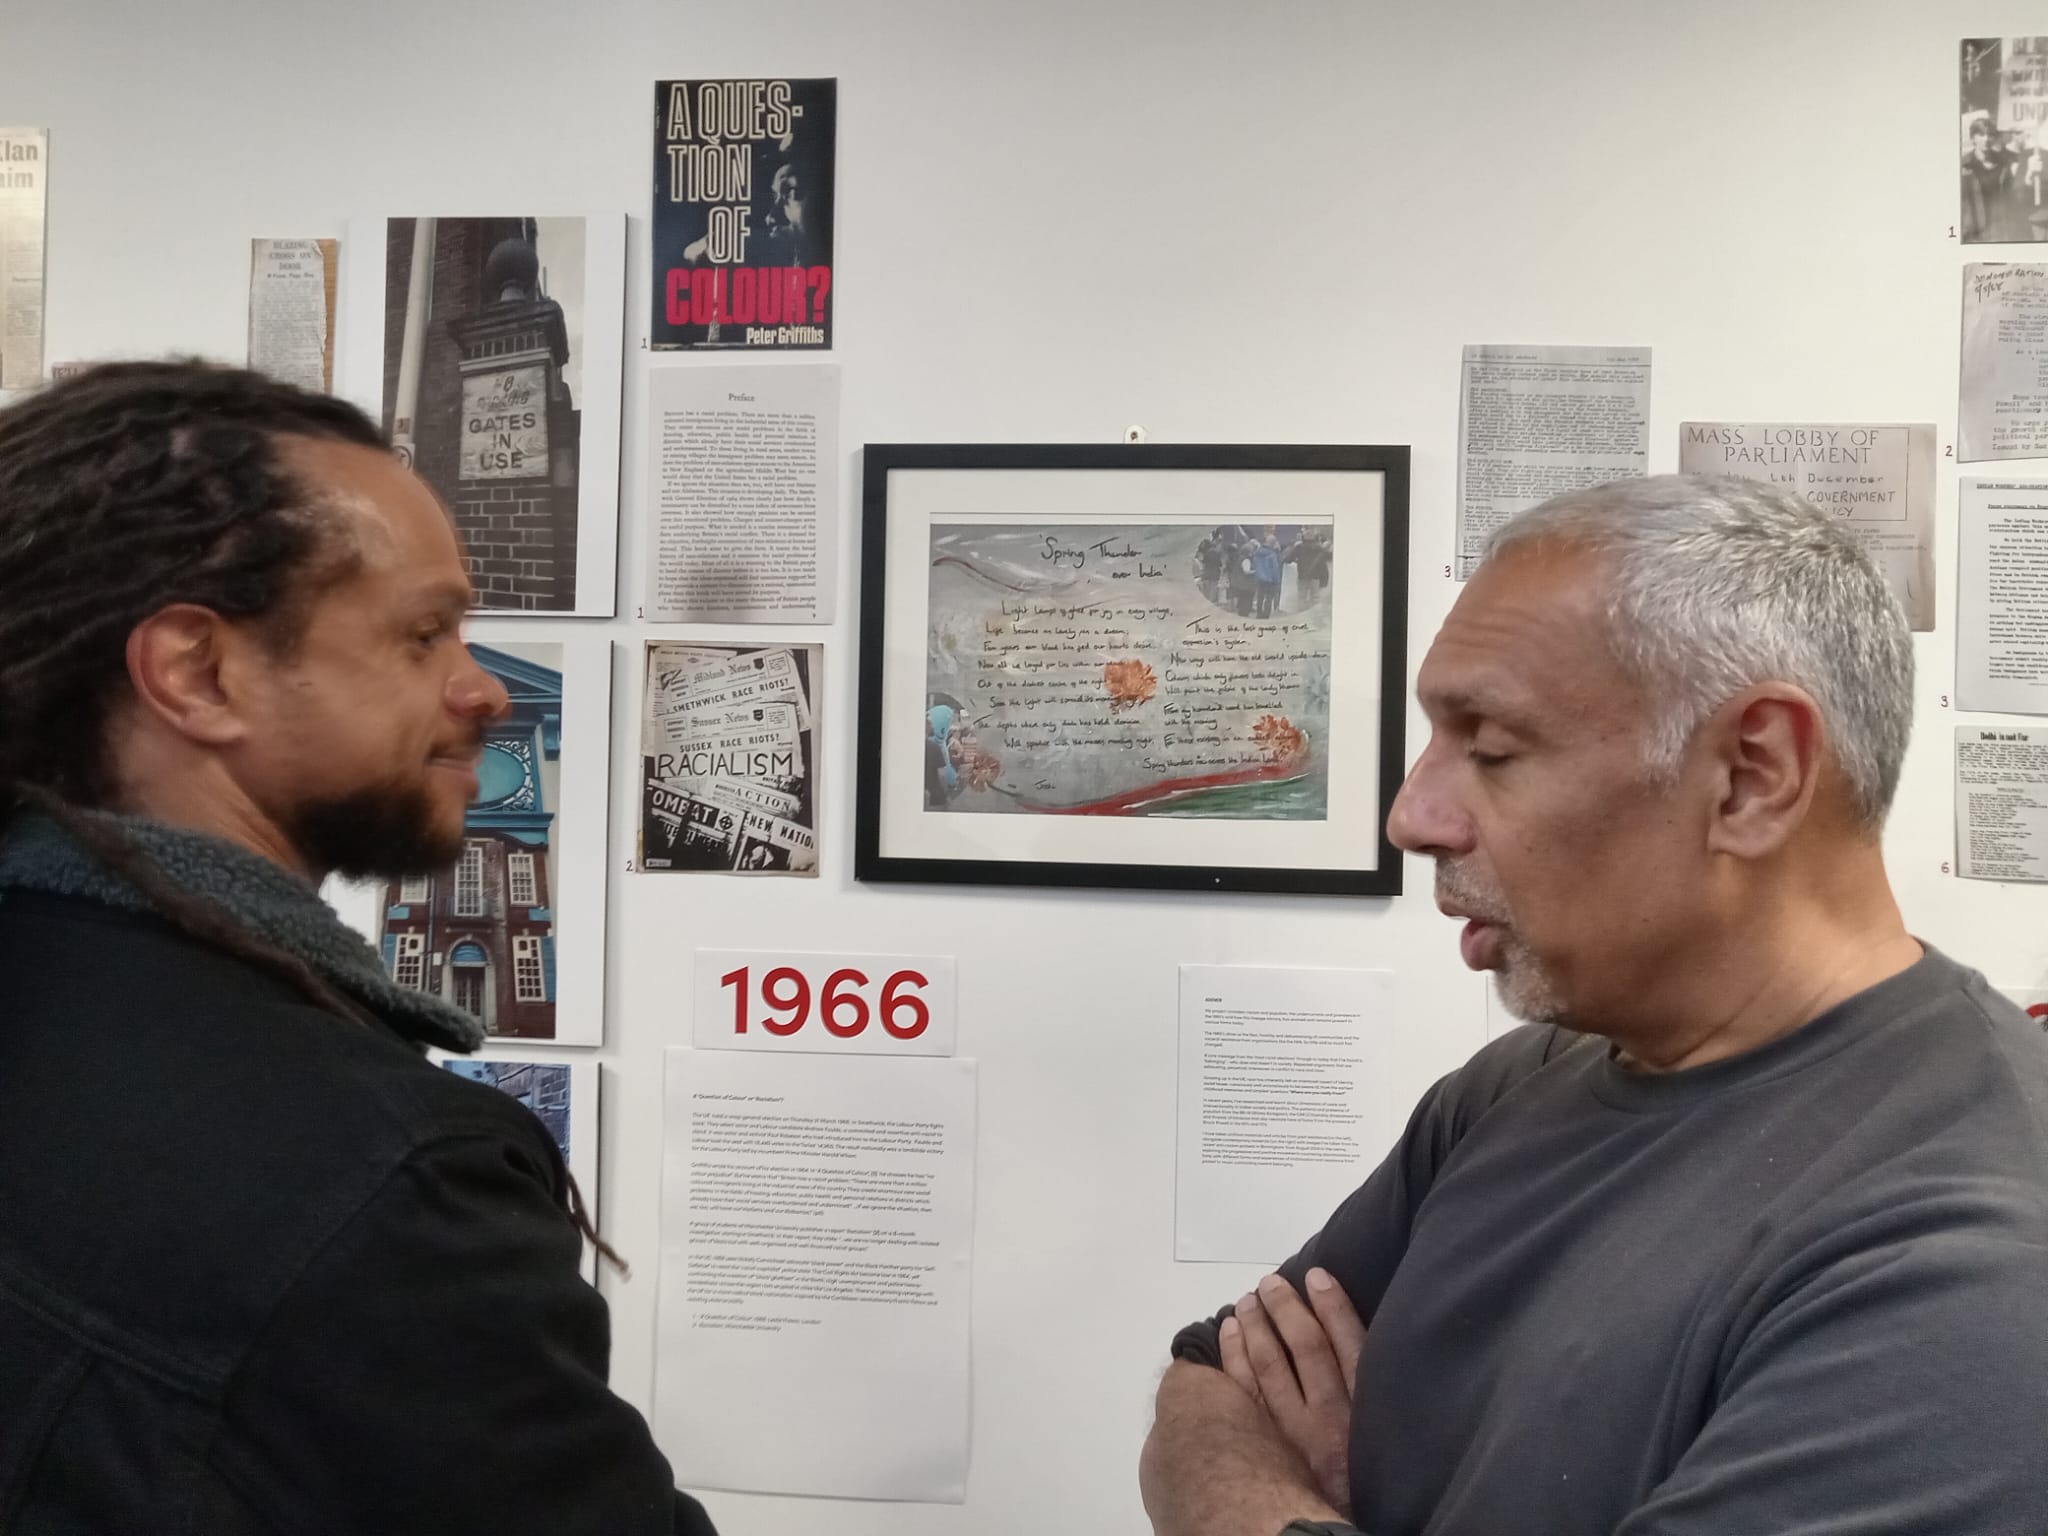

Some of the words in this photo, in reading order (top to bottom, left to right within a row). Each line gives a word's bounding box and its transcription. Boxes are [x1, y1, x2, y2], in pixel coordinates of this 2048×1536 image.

[667, 83, 692, 140] A
[698, 81, 804, 144] QUES-
[667, 144, 752, 202] TION
[707, 206, 751, 264] OF
[665, 265, 832, 326] COLOUR?
[641, 338, 648, 349] 1
[746, 327, 777, 345] Peter
[778, 327, 824, 345] Griffiths
[728, 392, 755, 402] Preface
[468, 412, 536, 434] GATES
[493, 432, 511, 449] IN
[1687, 426, 1744, 445] MASS
[1763, 428, 1839, 446] LOBBY
[1850, 429, 1879, 446] OF
[479, 451, 524, 471] USE
[1724, 446, 1872, 466] PARLIAMENT
[1945, 445, 1954, 457] 2
[1807, 472, 1885, 484] December
[1806, 490, 1896, 503] GOVERNMENT
[1445, 565, 1452, 578] 3
[637, 606, 644, 619] 1
[728, 661, 751, 675] News
[672, 692, 727, 714] SMETHWICK
[731, 686, 754, 699] RACE
[759, 677, 790, 692] RIOTS?
[1940, 695, 1949, 708] 3
[725, 713, 749, 724] News
[679, 741, 713, 753] SUSSEX
[719, 738, 743, 748] RACE
[748, 733, 780, 745] RIOTS?
[656, 751, 793, 778] RACIALISM
[652, 789, 714, 824] OMBAT
[735, 785, 793, 812] ACTION
[749, 813, 774, 833] NEW
[625, 860, 634, 873] 2
[1941, 861, 1950, 874] 6
[720, 965, 930, 1040] 1966
